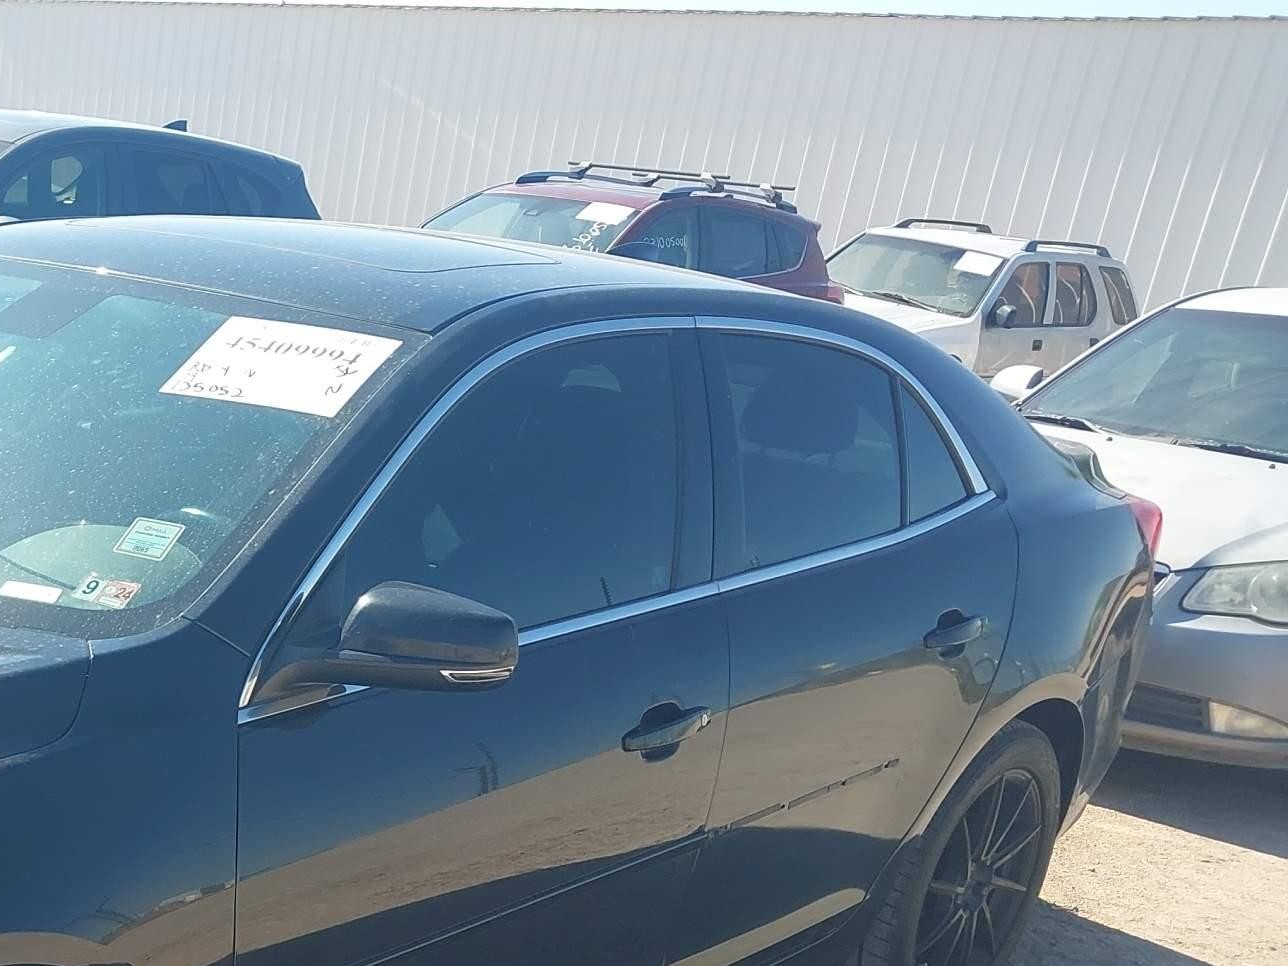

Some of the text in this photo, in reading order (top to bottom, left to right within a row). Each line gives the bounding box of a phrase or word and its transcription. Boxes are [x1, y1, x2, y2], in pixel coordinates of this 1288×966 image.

[226, 336, 362, 365] 45409994
[82, 580, 100, 595] 9
[115, 587, 132, 600] 24
